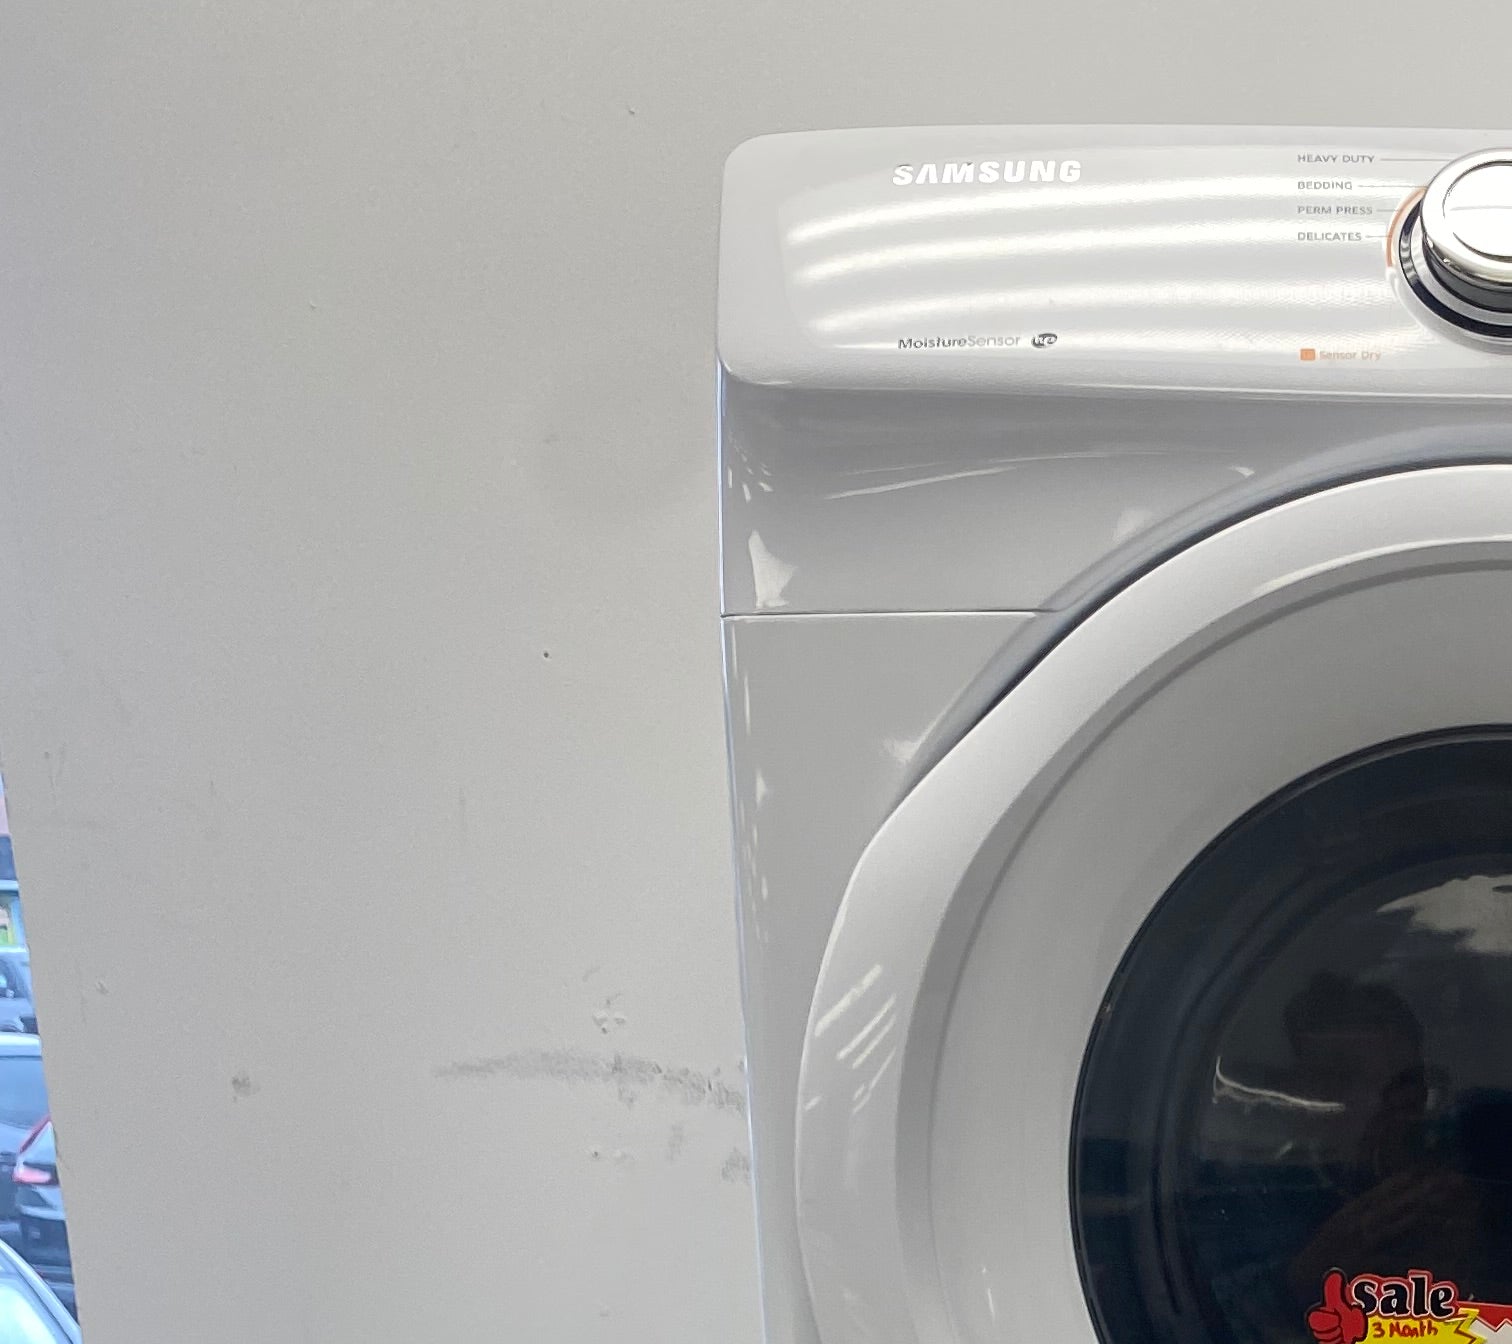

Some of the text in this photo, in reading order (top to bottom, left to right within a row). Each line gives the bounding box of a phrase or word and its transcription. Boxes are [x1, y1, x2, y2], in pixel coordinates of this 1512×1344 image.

[1297, 154, 1375, 164] HEAVY DUTY
[892, 159, 1082, 187] SAMSUNG
[1297, 181, 1353, 191] BEDDING
[1297, 205, 1373, 216] PERM PRESS
[1297, 231, 1362, 241] DELICATES
[1319, 350, 1382, 363] Sensor Dry
[1352, 1272, 1458, 1319] sale
[1373, 1320, 1439, 1338] 3 Month
